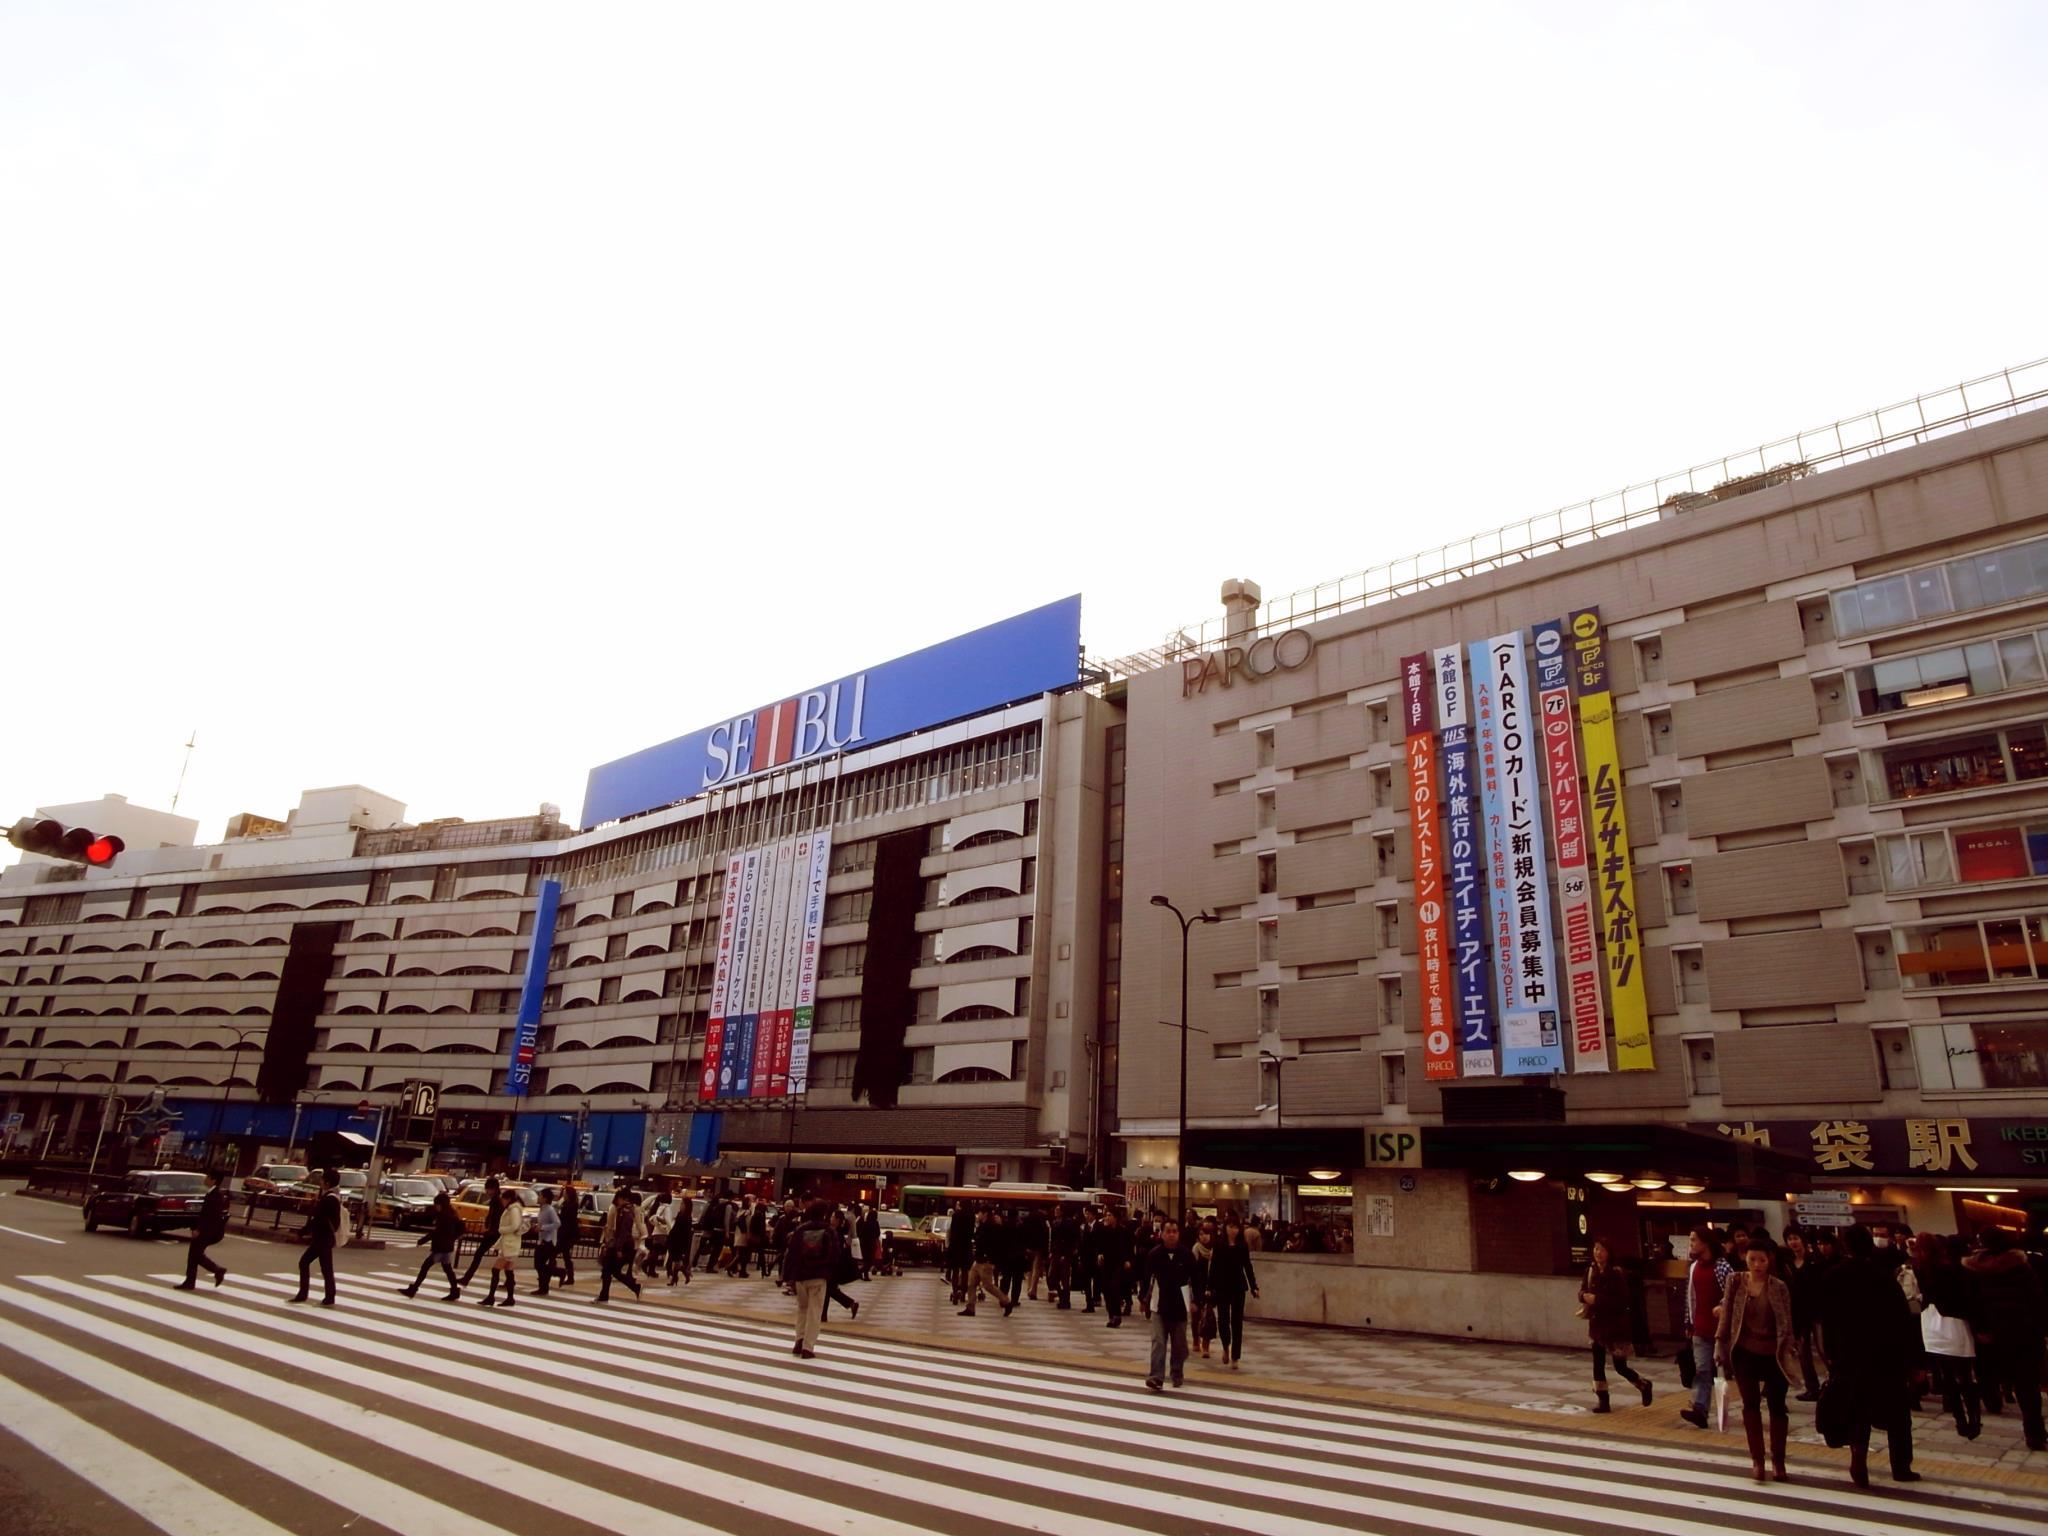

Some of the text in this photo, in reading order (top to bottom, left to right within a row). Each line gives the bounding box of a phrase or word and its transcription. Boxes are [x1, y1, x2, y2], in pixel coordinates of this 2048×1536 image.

[1182, 628, 1313, 698] PARCO
[1440, 653, 1458, 718] 本館6F
[1583, 671, 1601, 686] 8F
[702, 674, 866, 788] SEIBU
[1444, 727, 1466, 743] HIS
[1546, 697, 1565, 712] 7F
[1411, 737, 1436, 897] パルコのレストラン
[1552, 740, 1580, 859] イシバシ楽器
[1593, 763, 1634, 988] ムラサキスポーツ
[1968, 839, 2012, 850] REGAL
[1447, 751, 1488, 1043] 海外旅行のエイチ・アイ・エス
[1424, 927, 1444, 1027] 夜11時まで営業
[1566, 902, 1602, 1054] TOWER RECORDS
[514, 1023, 539, 1085] SEIBU
[1426, 1060, 1454, 1072] PARCO
[1464, 1057, 1492, 1069] PARCO
[1518, 1055, 1548, 1066] PARCO
[854, 1157, 927, 1170] LOUIS VUITTON
[1370, 1133, 1415, 1162] ISP
